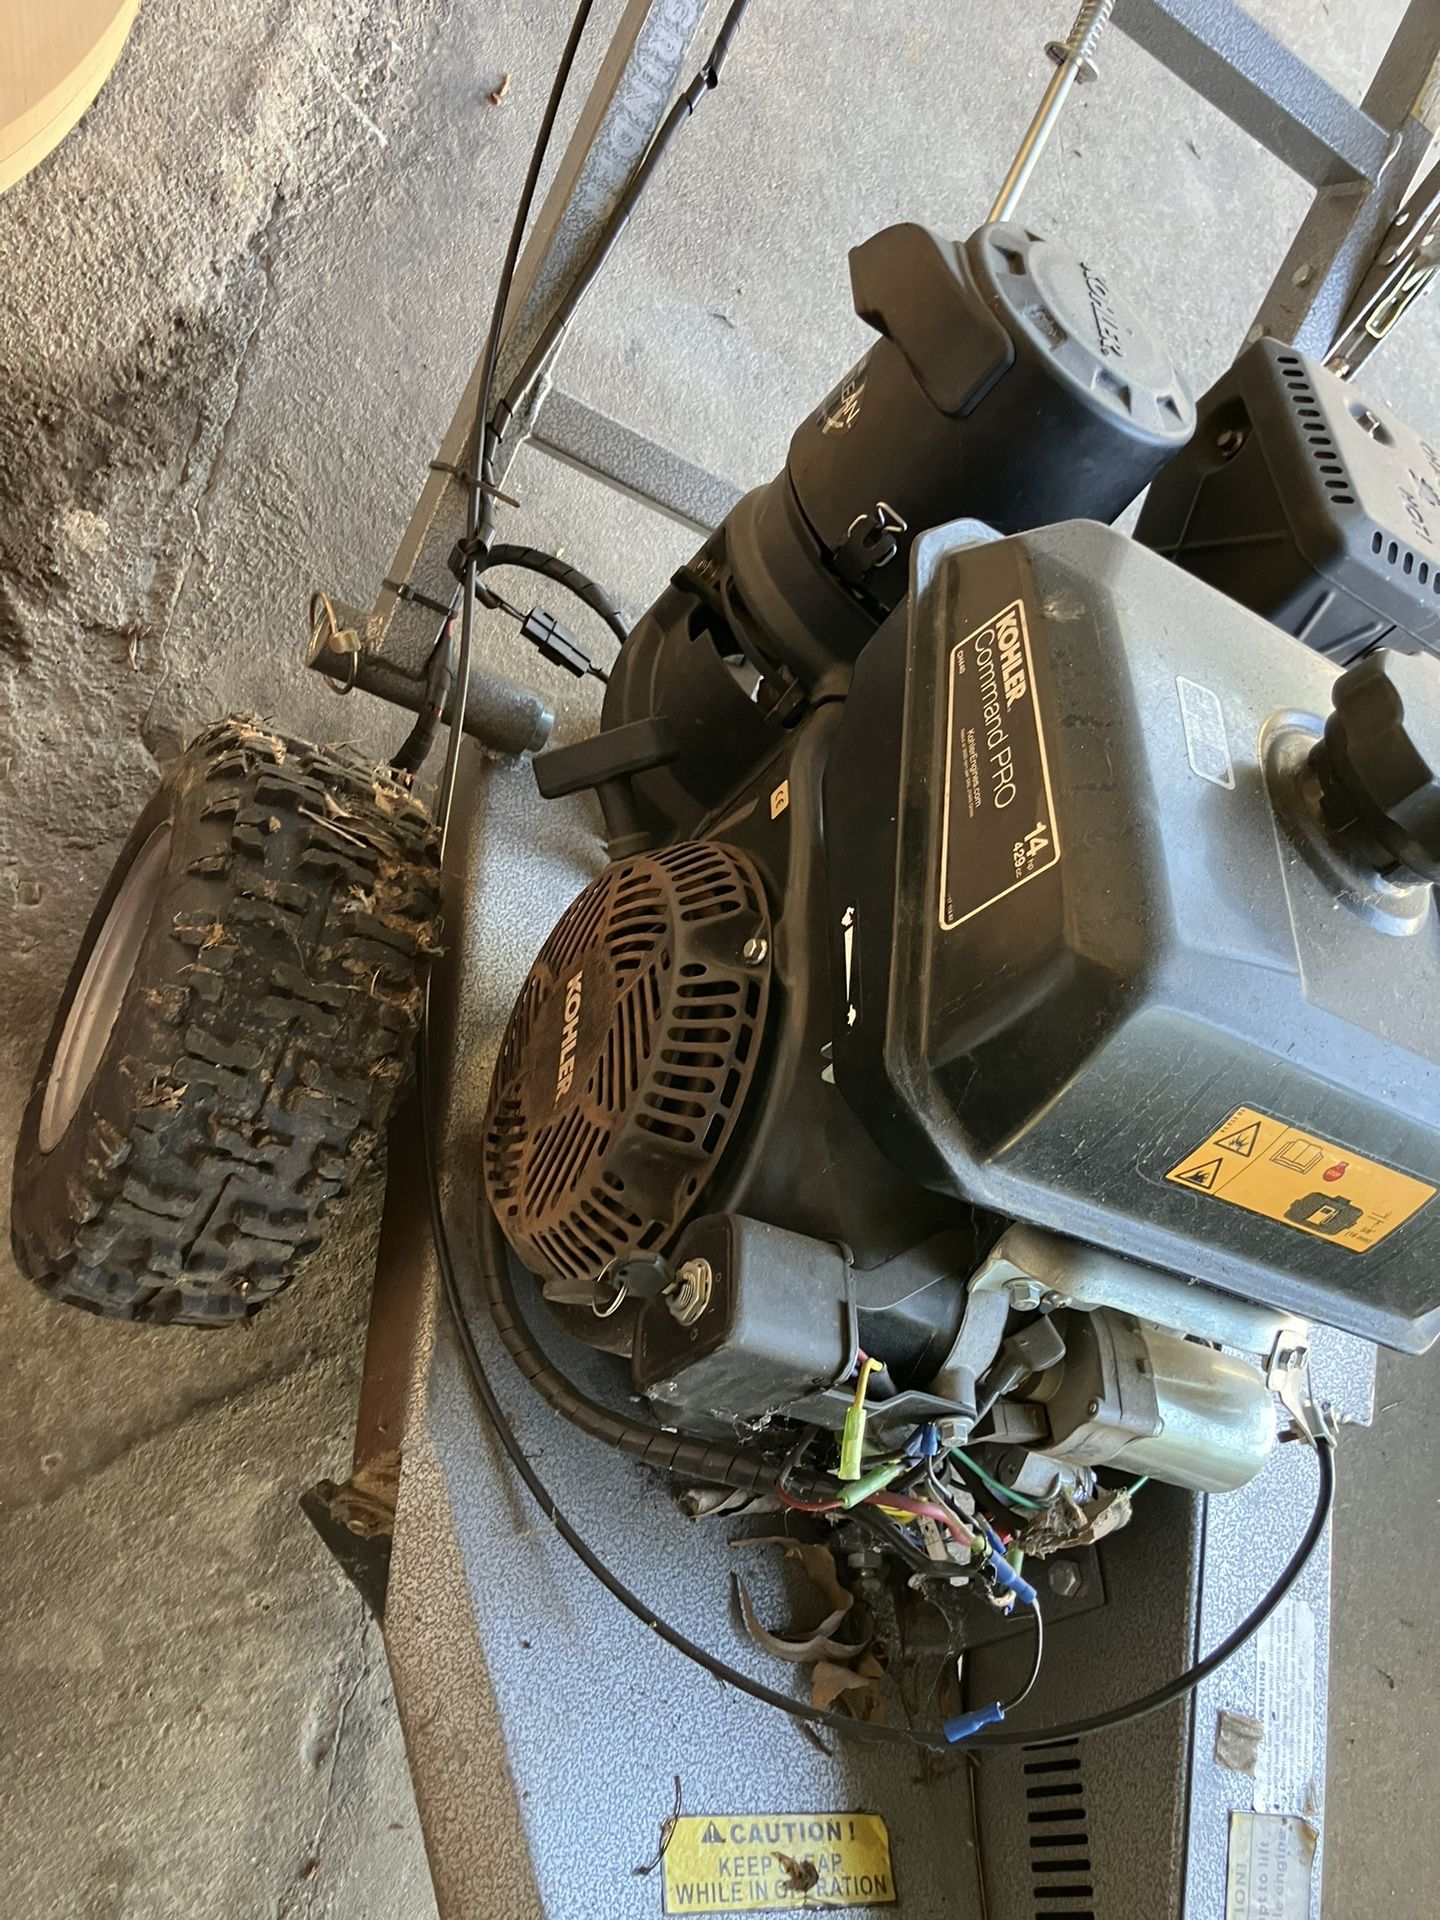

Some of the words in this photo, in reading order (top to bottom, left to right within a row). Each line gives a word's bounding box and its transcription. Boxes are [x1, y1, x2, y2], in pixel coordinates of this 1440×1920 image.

[995, 610, 1026, 708] KOHLER
[974, 628, 1010, 750] Command
[989, 746, 1017, 809] PRO
[1024, 821, 1049, 857] 14
[1013, 842, 1026, 868] 429
[555, 970, 583, 1103] KOHLER
[719, 1856, 772, 1878] KEEP
[1258, 1841, 1269, 1867] lift
[676, 1882, 743, 1905] WHILE
[749, 1880, 769, 1902] IN
[1258, 1872, 1268, 1891] to
